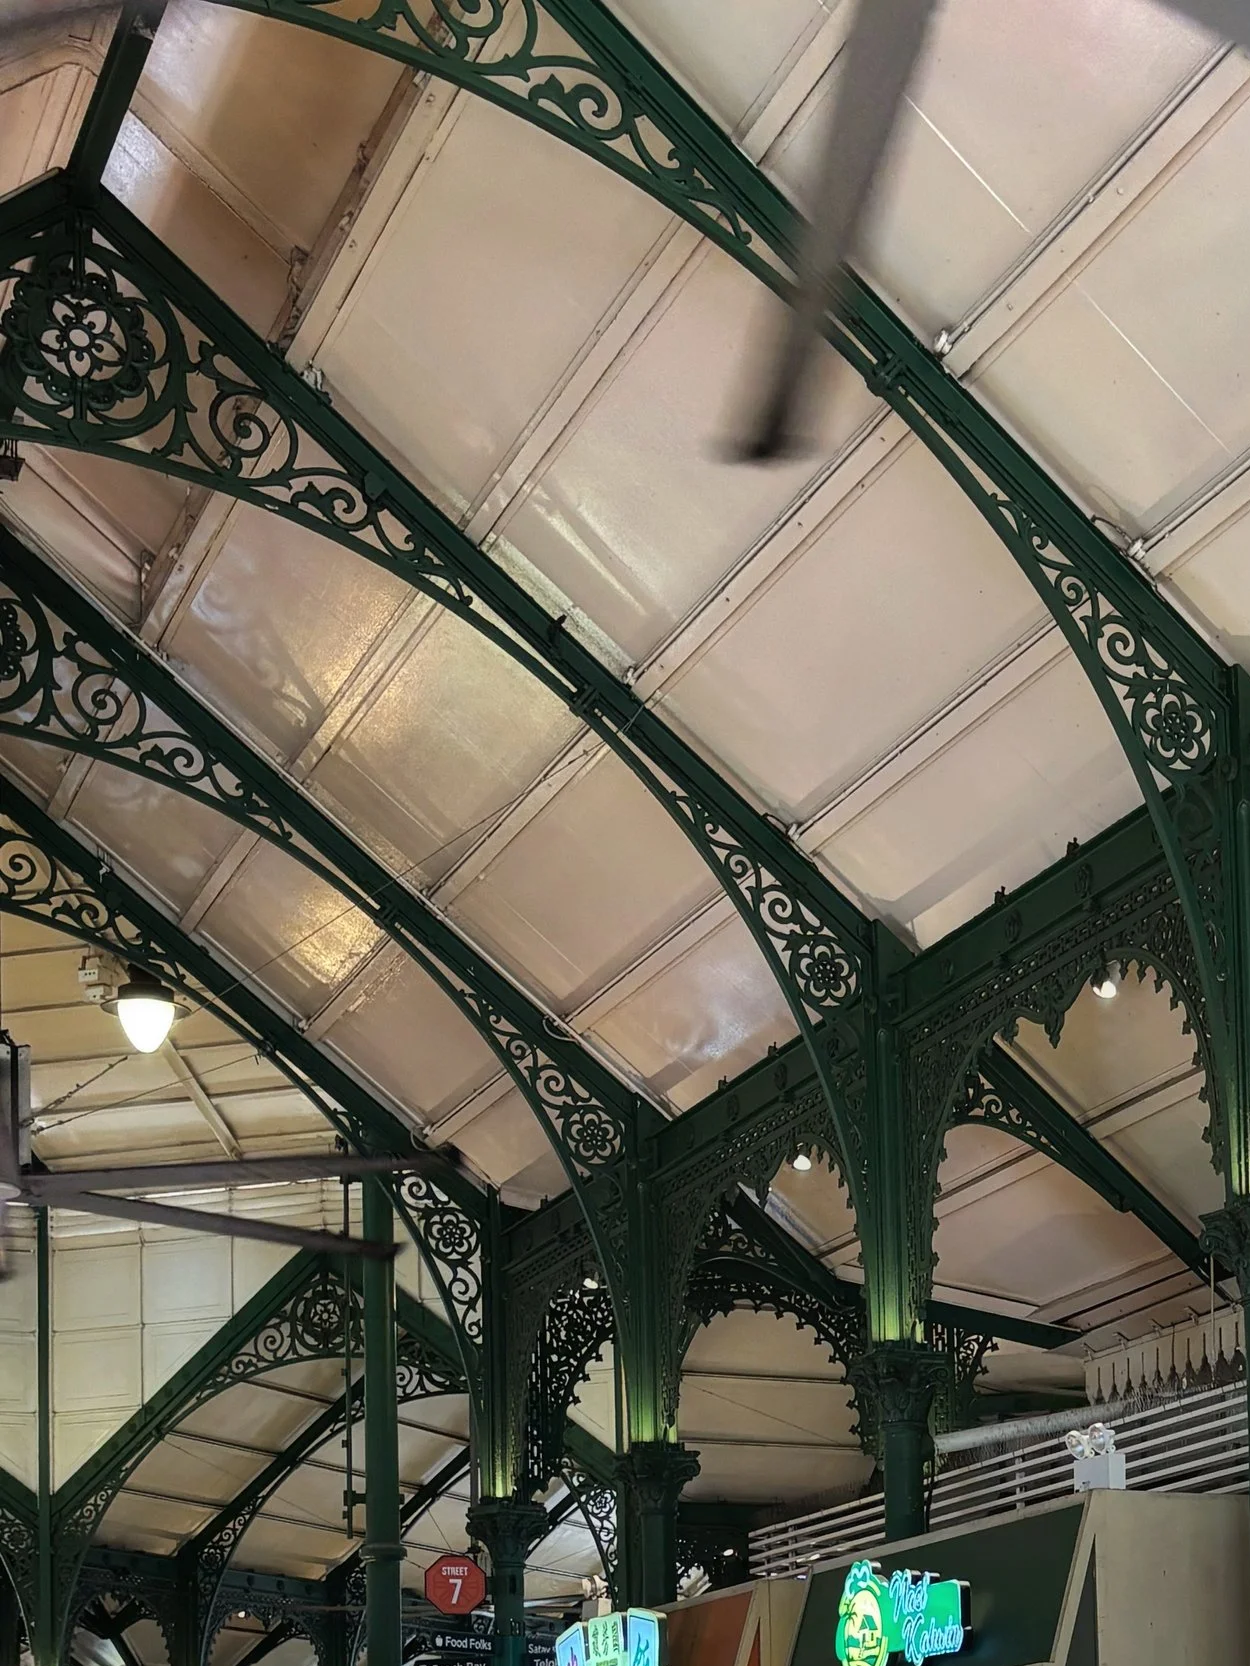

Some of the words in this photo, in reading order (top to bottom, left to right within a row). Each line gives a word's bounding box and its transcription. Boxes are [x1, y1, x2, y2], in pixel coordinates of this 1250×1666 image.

[441, 1566, 469, 1577] STREET
[449, 1578, 463, 1605] 7
[445, 1635, 468, 1649] Food
[469, 1638, 493, 1651] Folks
